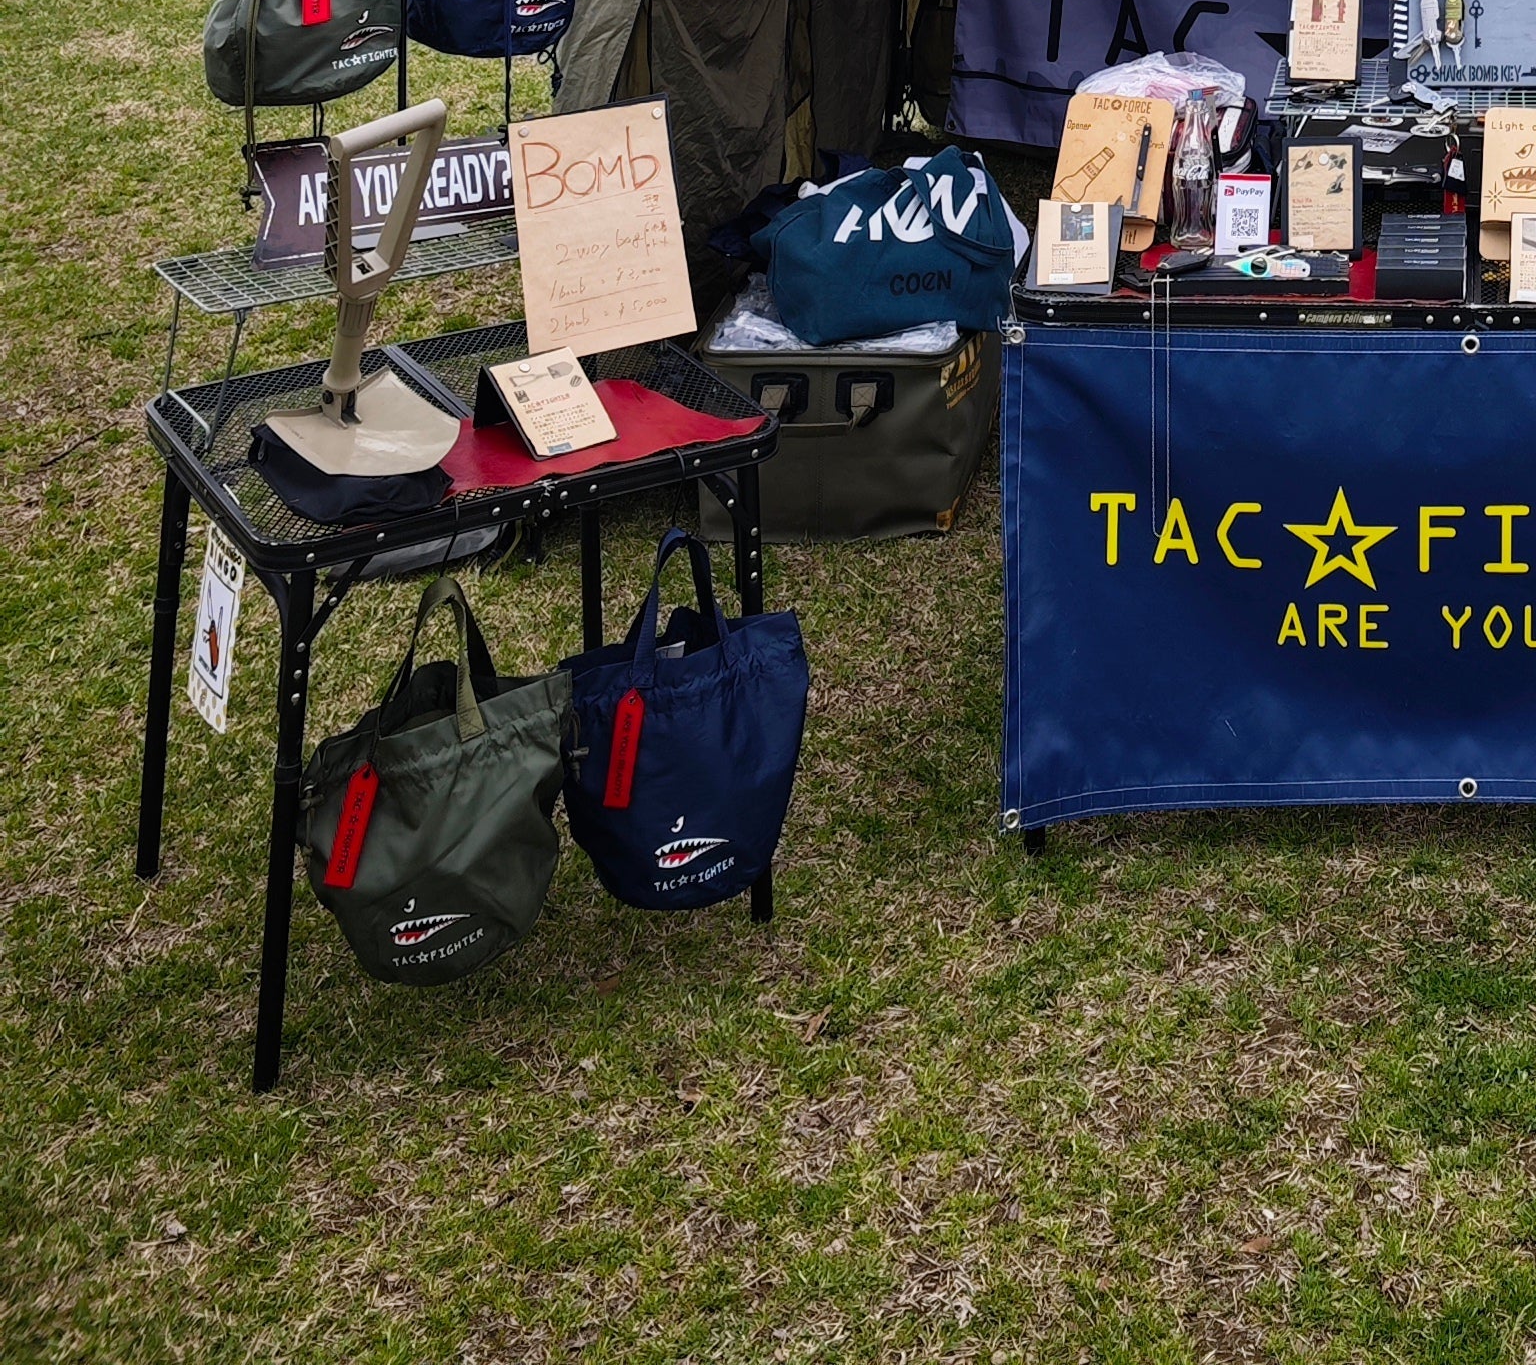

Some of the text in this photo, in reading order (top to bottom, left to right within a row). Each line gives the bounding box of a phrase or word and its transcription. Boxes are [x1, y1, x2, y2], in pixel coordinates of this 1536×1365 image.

[331, 56, 351, 70] TAC
[1469, 65, 1499, 83] BOMB
[1500, 65, 1522, 82] KEY
[1093, 97, 1152, 113] TAC FORCE
[1491, 121, 1524, 136] Light
[298, 172, 328, 226] AR
[1235, 187, 1265, 198] PayPay
[1124, 229, 1137, 245] it!
[1089, 491, 1263, 569] TAC
[1277, 603, 1389, 650] ARE
[653, 856, 735, 893] TAC FIGHTER
[392, 927, 484, 967] TAC FIGHTER
